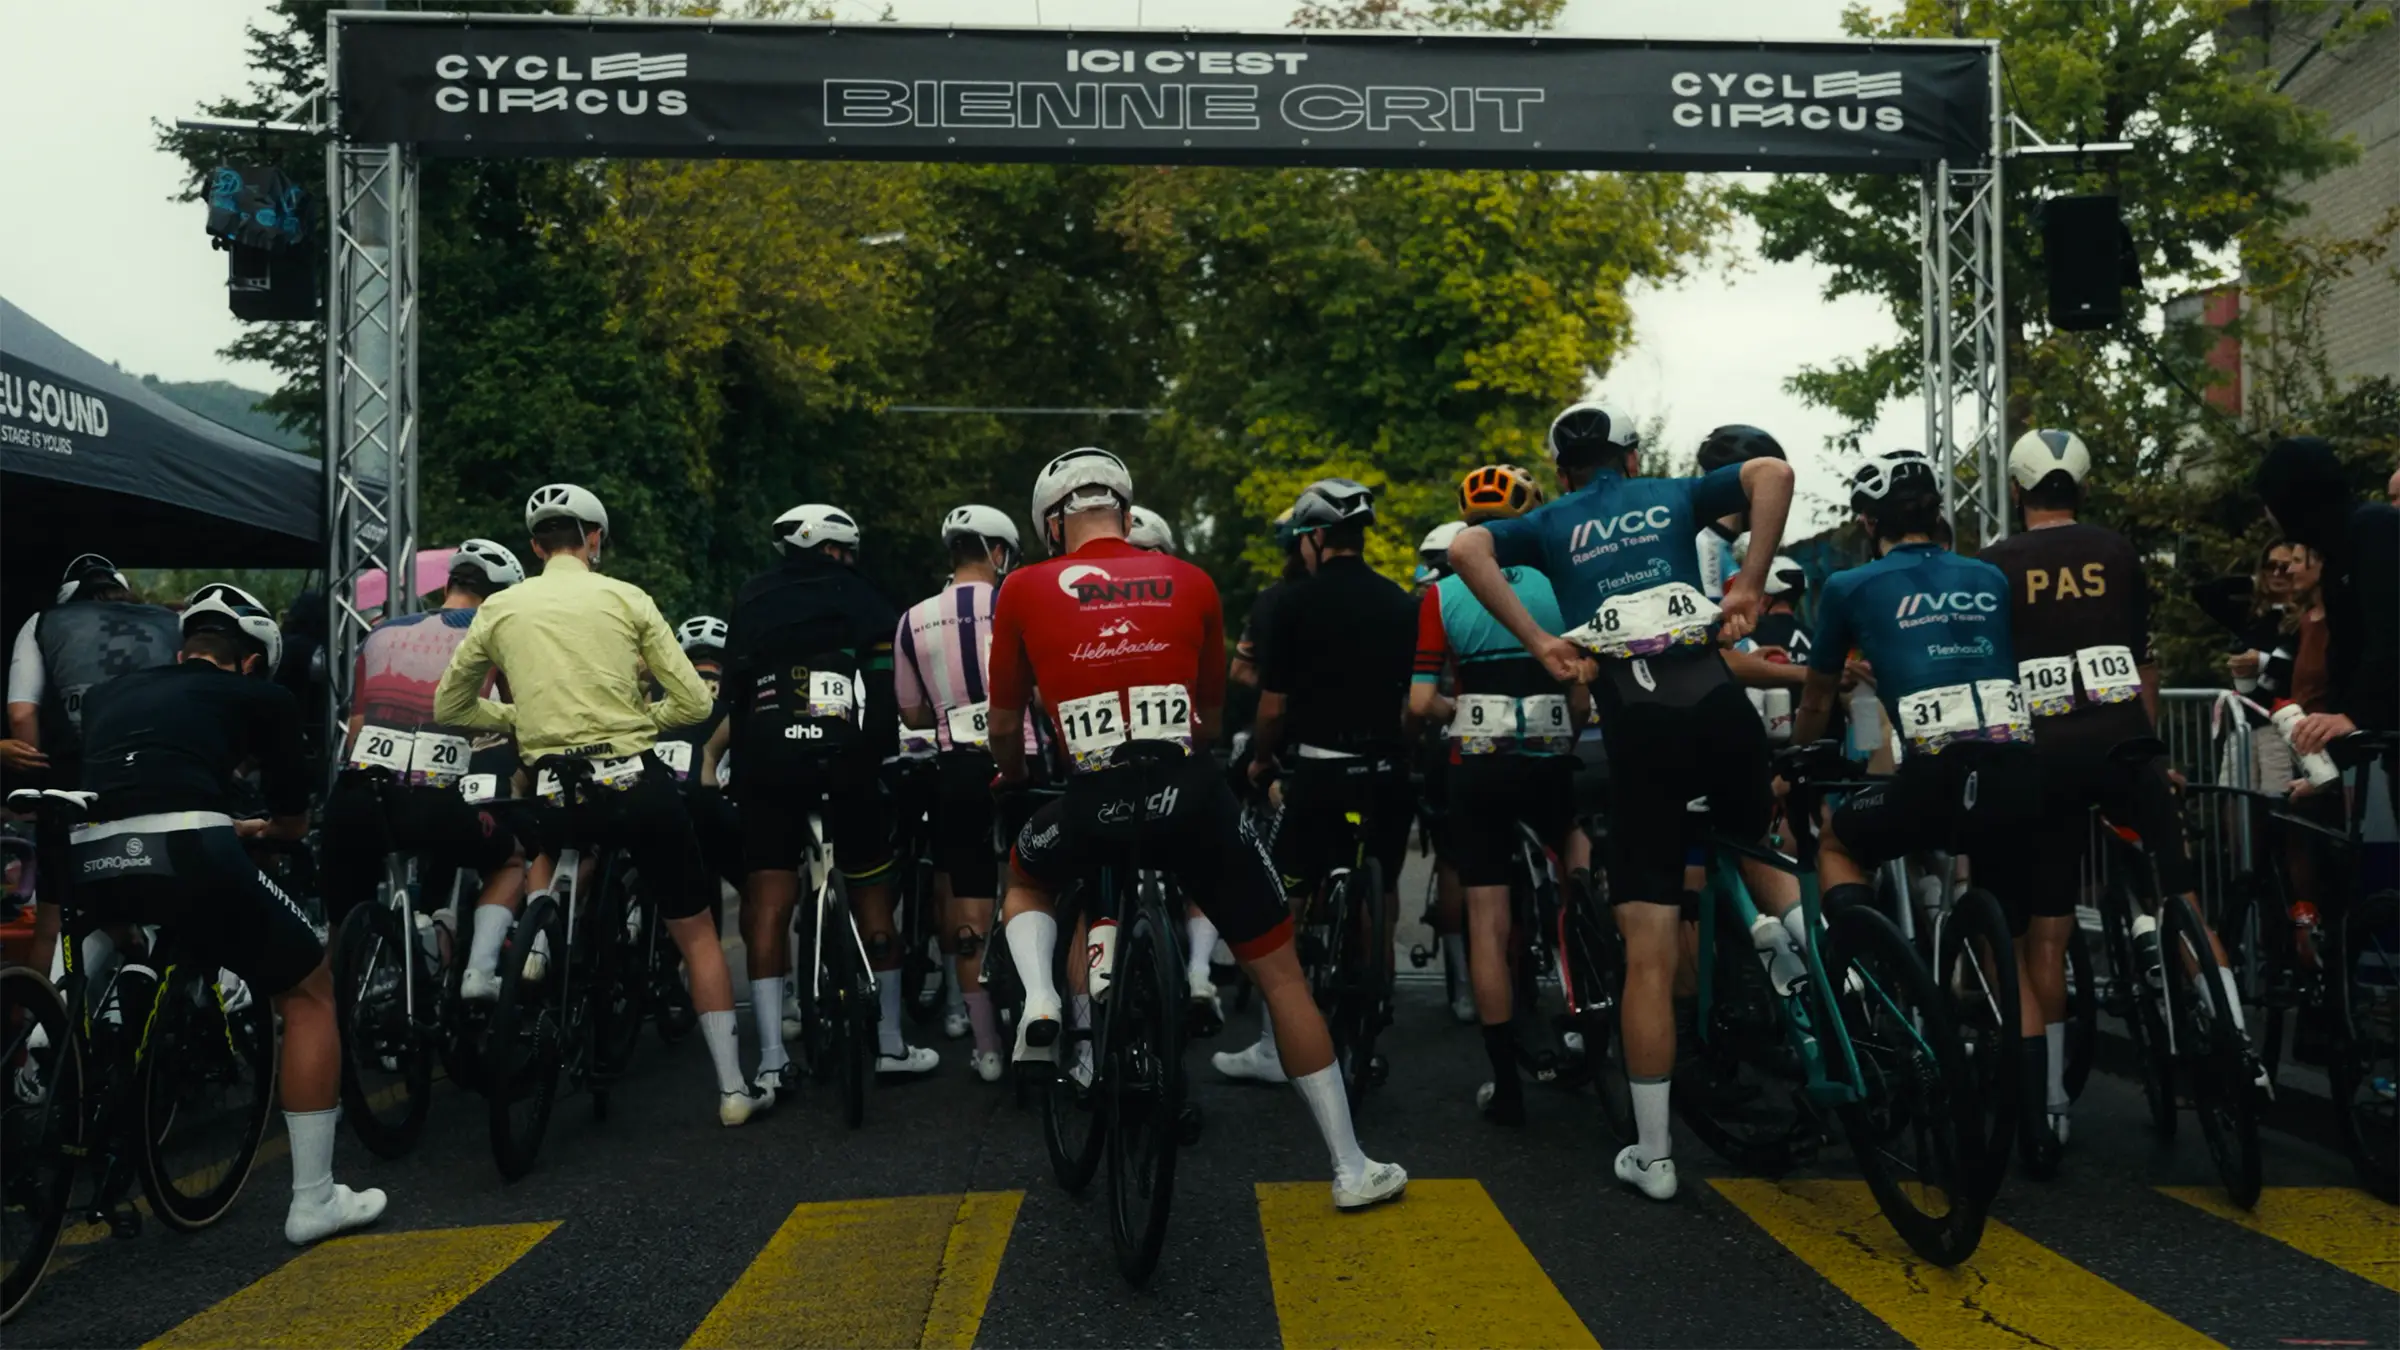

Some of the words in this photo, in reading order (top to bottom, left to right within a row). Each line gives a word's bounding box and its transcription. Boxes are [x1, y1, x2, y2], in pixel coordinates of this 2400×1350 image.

[1067, 49, 1134, 73] ICI
[1145, 50, 1308, 75] C'EST
[823, 79, 1260, 130] BIENNE
[1280, 84, 1545, 133] CRIT
[28, 380, 109, 437] SOUND
[1, 424, 31, 446] STAGE
[32, 431, 41, 448] IS
[42, 433, 73, 455] YOURS
[1572, 542, 1620, 566] Racing
[1620, 533, 1660, 548] Team
[1597, 567, 1661, 594] Flexhaus
[2026, 563, 2107, 604] PAS
[1668, 594, 1697, 618] 48
[1588, 608, 1620, 633] 48
[1898, 614, 1949, 630] Racing
[1950, 612, 1986, 622] Team
[1069, 638, 1171, 662] Helmbacher
[2025, 667, 2067, 690] 103
[2088, 656, 2129, 678] 103
[821, 680, 844, 696] 18
[1136, 699, 1188, 726] 112
[1914, 700, 1941, 725] 31
[2006, 691, 2026, 712] 31
[1064, 708, 1115, 740] 112
[1472, 705, 1484, 726] 9
[1551, 706, 1563, 726] 9
[784, 724, 823, 739] dhb
[367, 737, 394, 757] 20
[432, 744, 457, 764] 20
